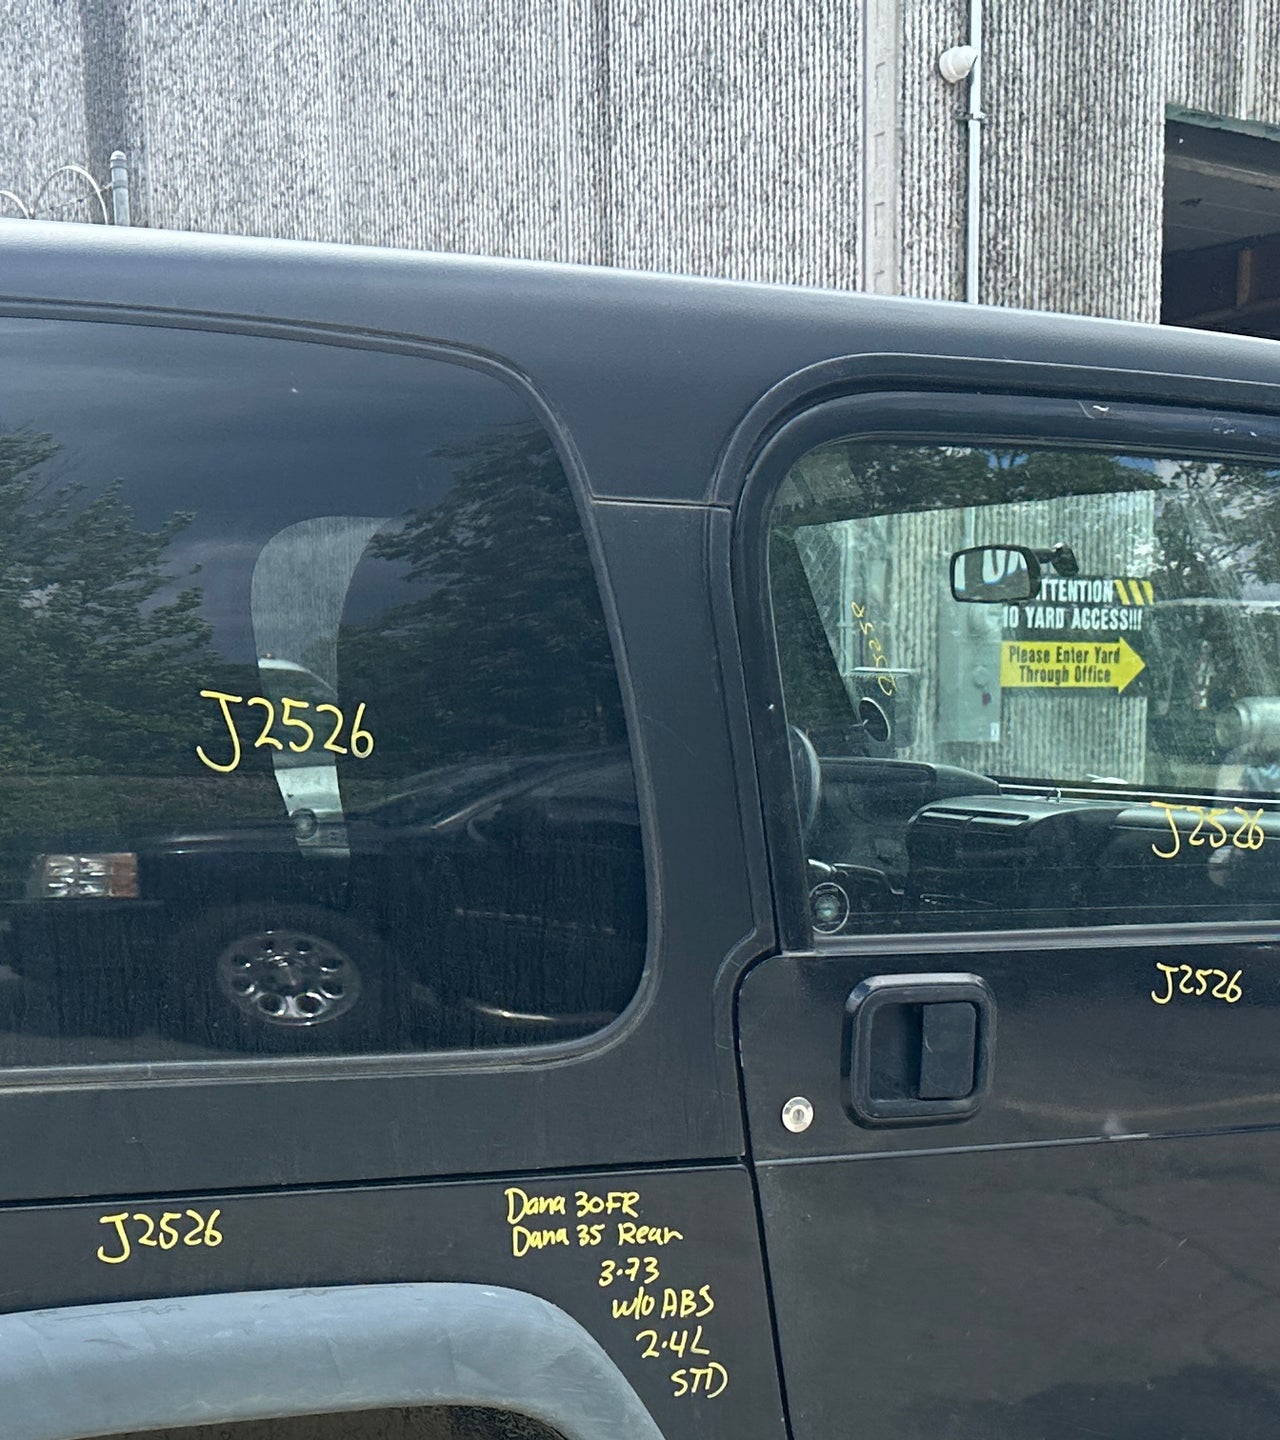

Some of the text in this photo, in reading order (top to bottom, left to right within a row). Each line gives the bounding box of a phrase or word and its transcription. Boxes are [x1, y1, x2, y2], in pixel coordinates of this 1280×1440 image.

[1036, 578, 1114, 603] TTENTION
[1025, 606, 1065, 630] YARD
[1071, 607, 1143, 631] ACCESS!!!
[1008, 646, 1120, 664] Please Enter Yard
[1020, 666, 1111, 685] Through Office
[195, 689, 376, 773] J2526
[1150, 801, 1265, 859] J2526
[1151, 962, 1243, 1005] J2526
[504, 1187, 567, 1225] Dana
[97, 1209, 223, 1264] J2526
[512, 1222, 684, 1257] Dana 35 Rear
[660, 1284, 715, 1319] ABS
[670, 1361, 729, 1399] STD
